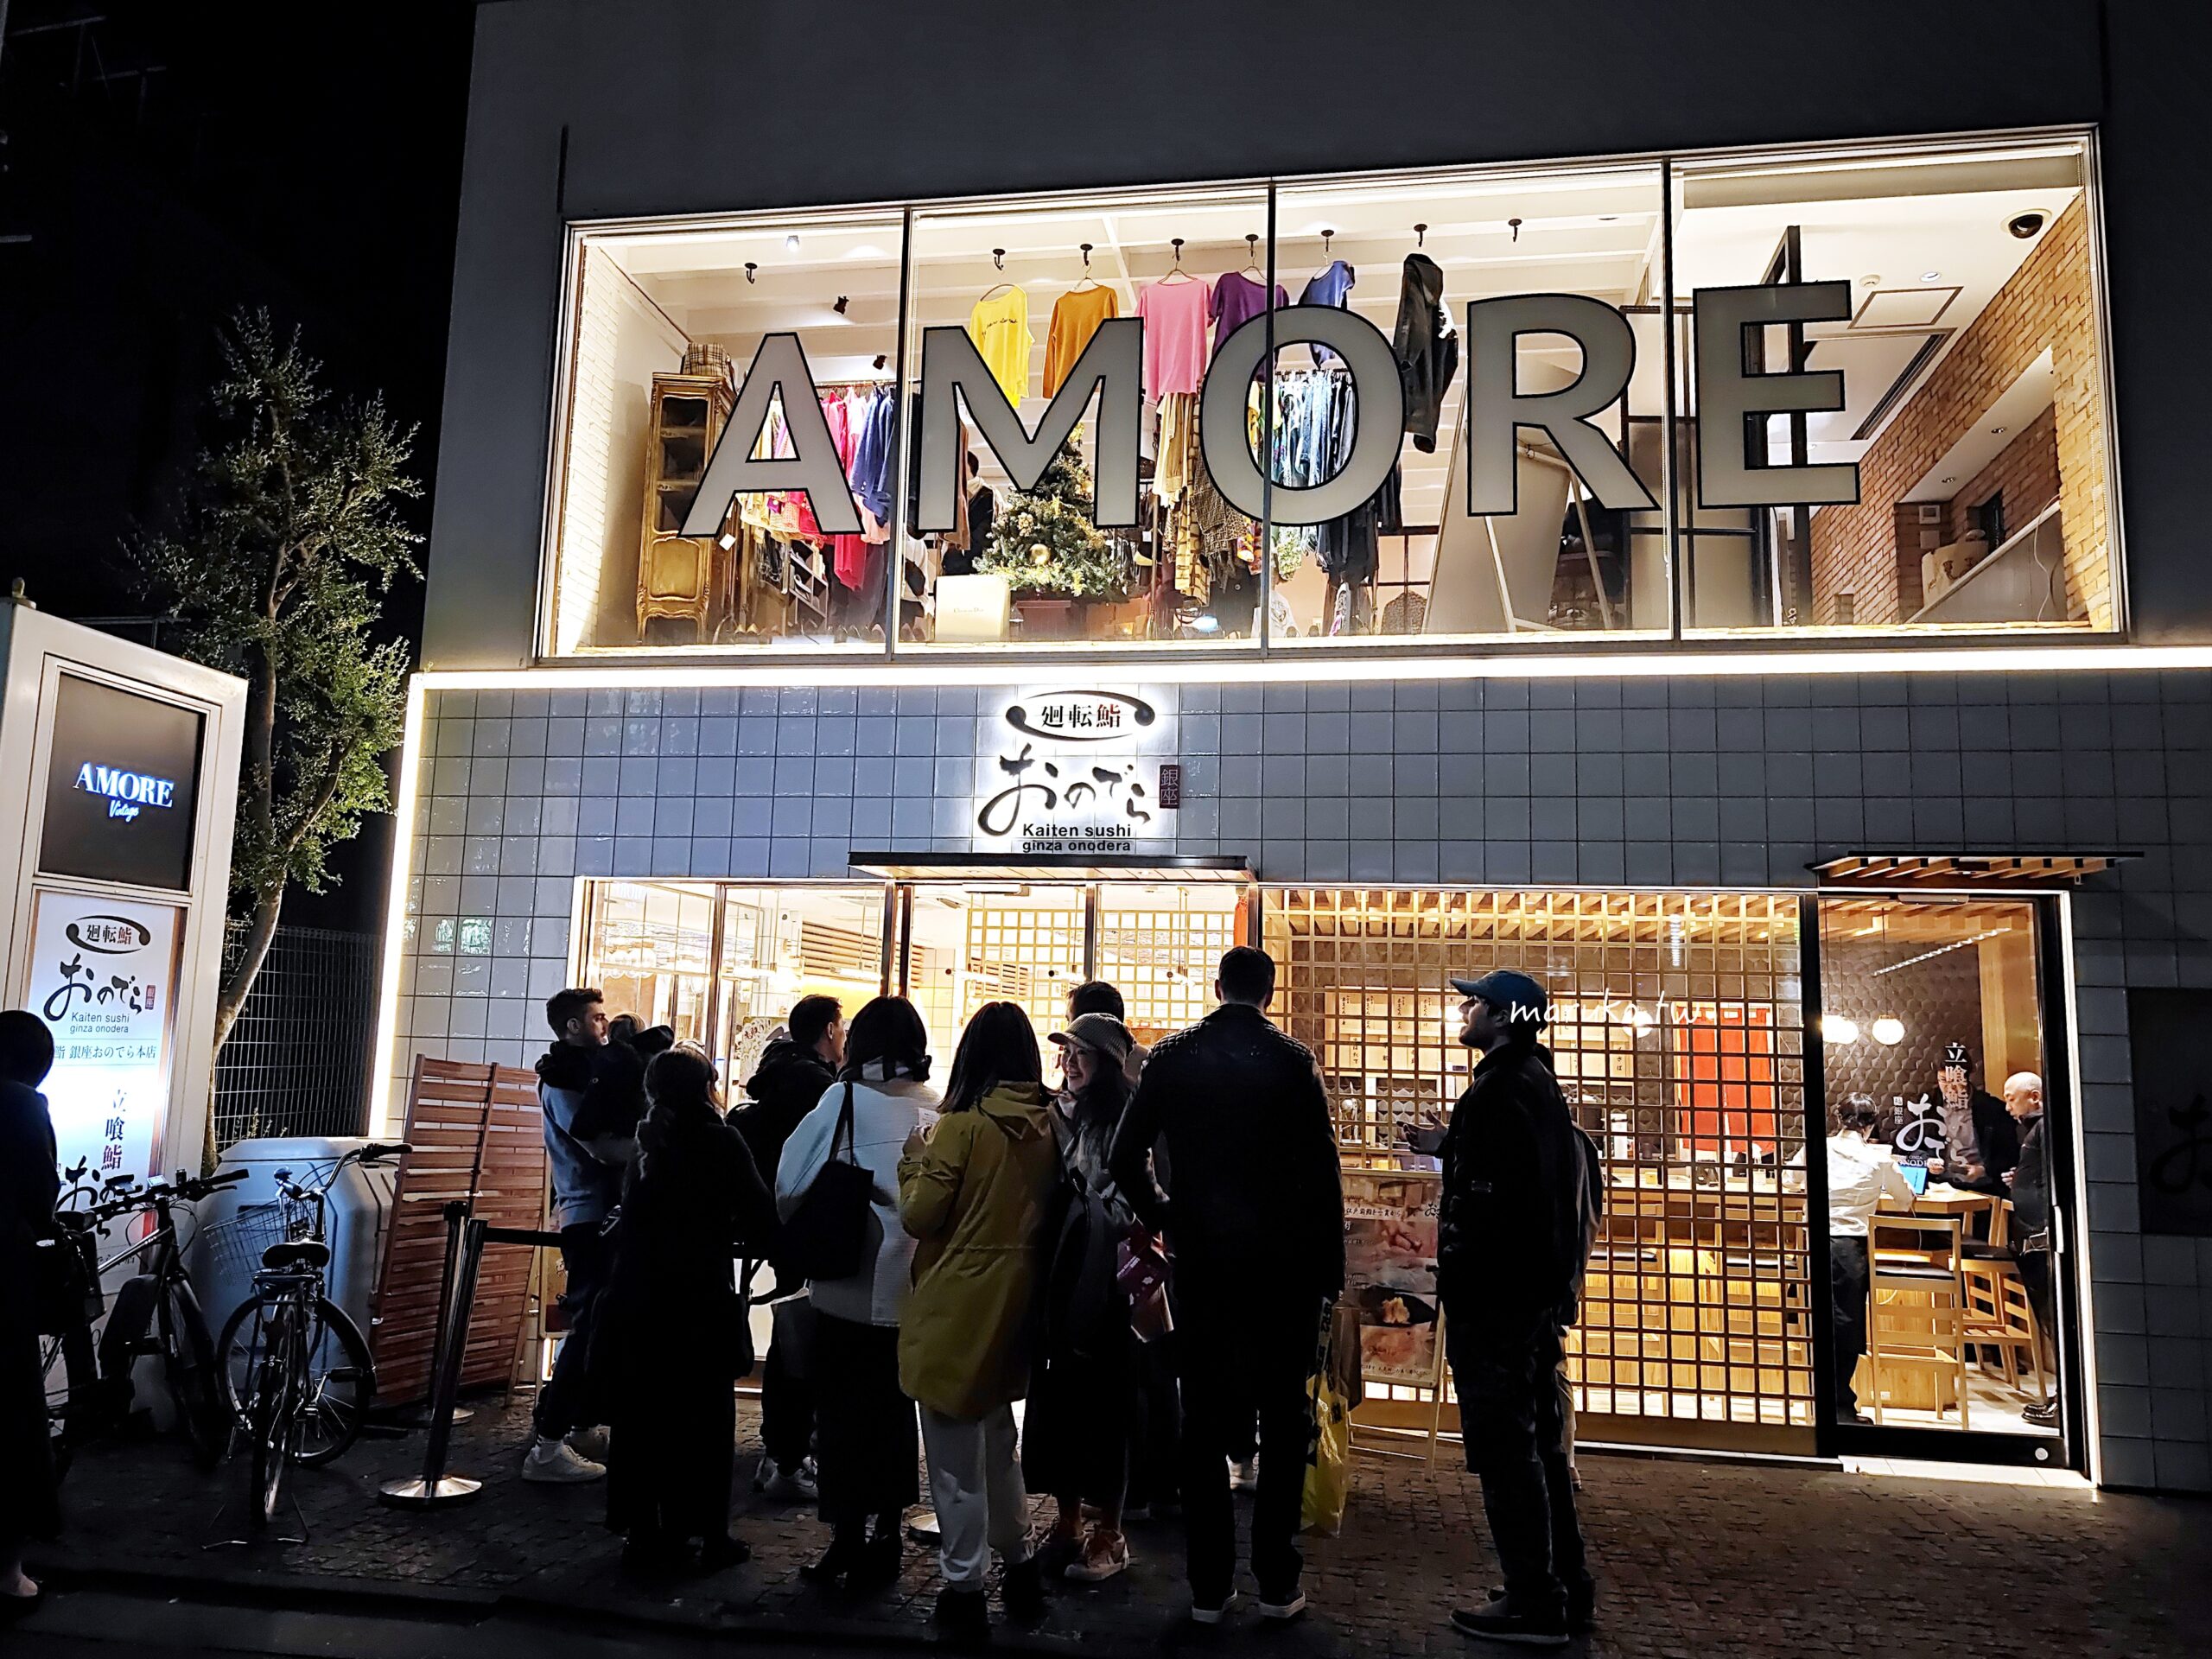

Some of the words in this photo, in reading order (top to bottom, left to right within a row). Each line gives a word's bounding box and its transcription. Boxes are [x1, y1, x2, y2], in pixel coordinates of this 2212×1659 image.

[677, 280, 1861, 538] AMORE
[1040, 704, 1121, 728] 廻転鮨
[73, 761, 175, 808] AMORE
[977, 742, 1151, 836] おのでら
[1023, 823, 1079, 836] Kaiten
[1085, 823, 1131, 836] sushi
[1023, 839, 1063, 853] ginza
[1068, 839, 1131, 851] onodera
[86, 924, 132, 944] 廻転鮨
[44, 953, 142, 1021] おのでら
[71, 1012, 102, 1022] Kaiten
[105, 1013, 130, 1023] sushi
[69, 1024, 92, 1034] ginza
[95, 1024, 129, 1033] onodera
